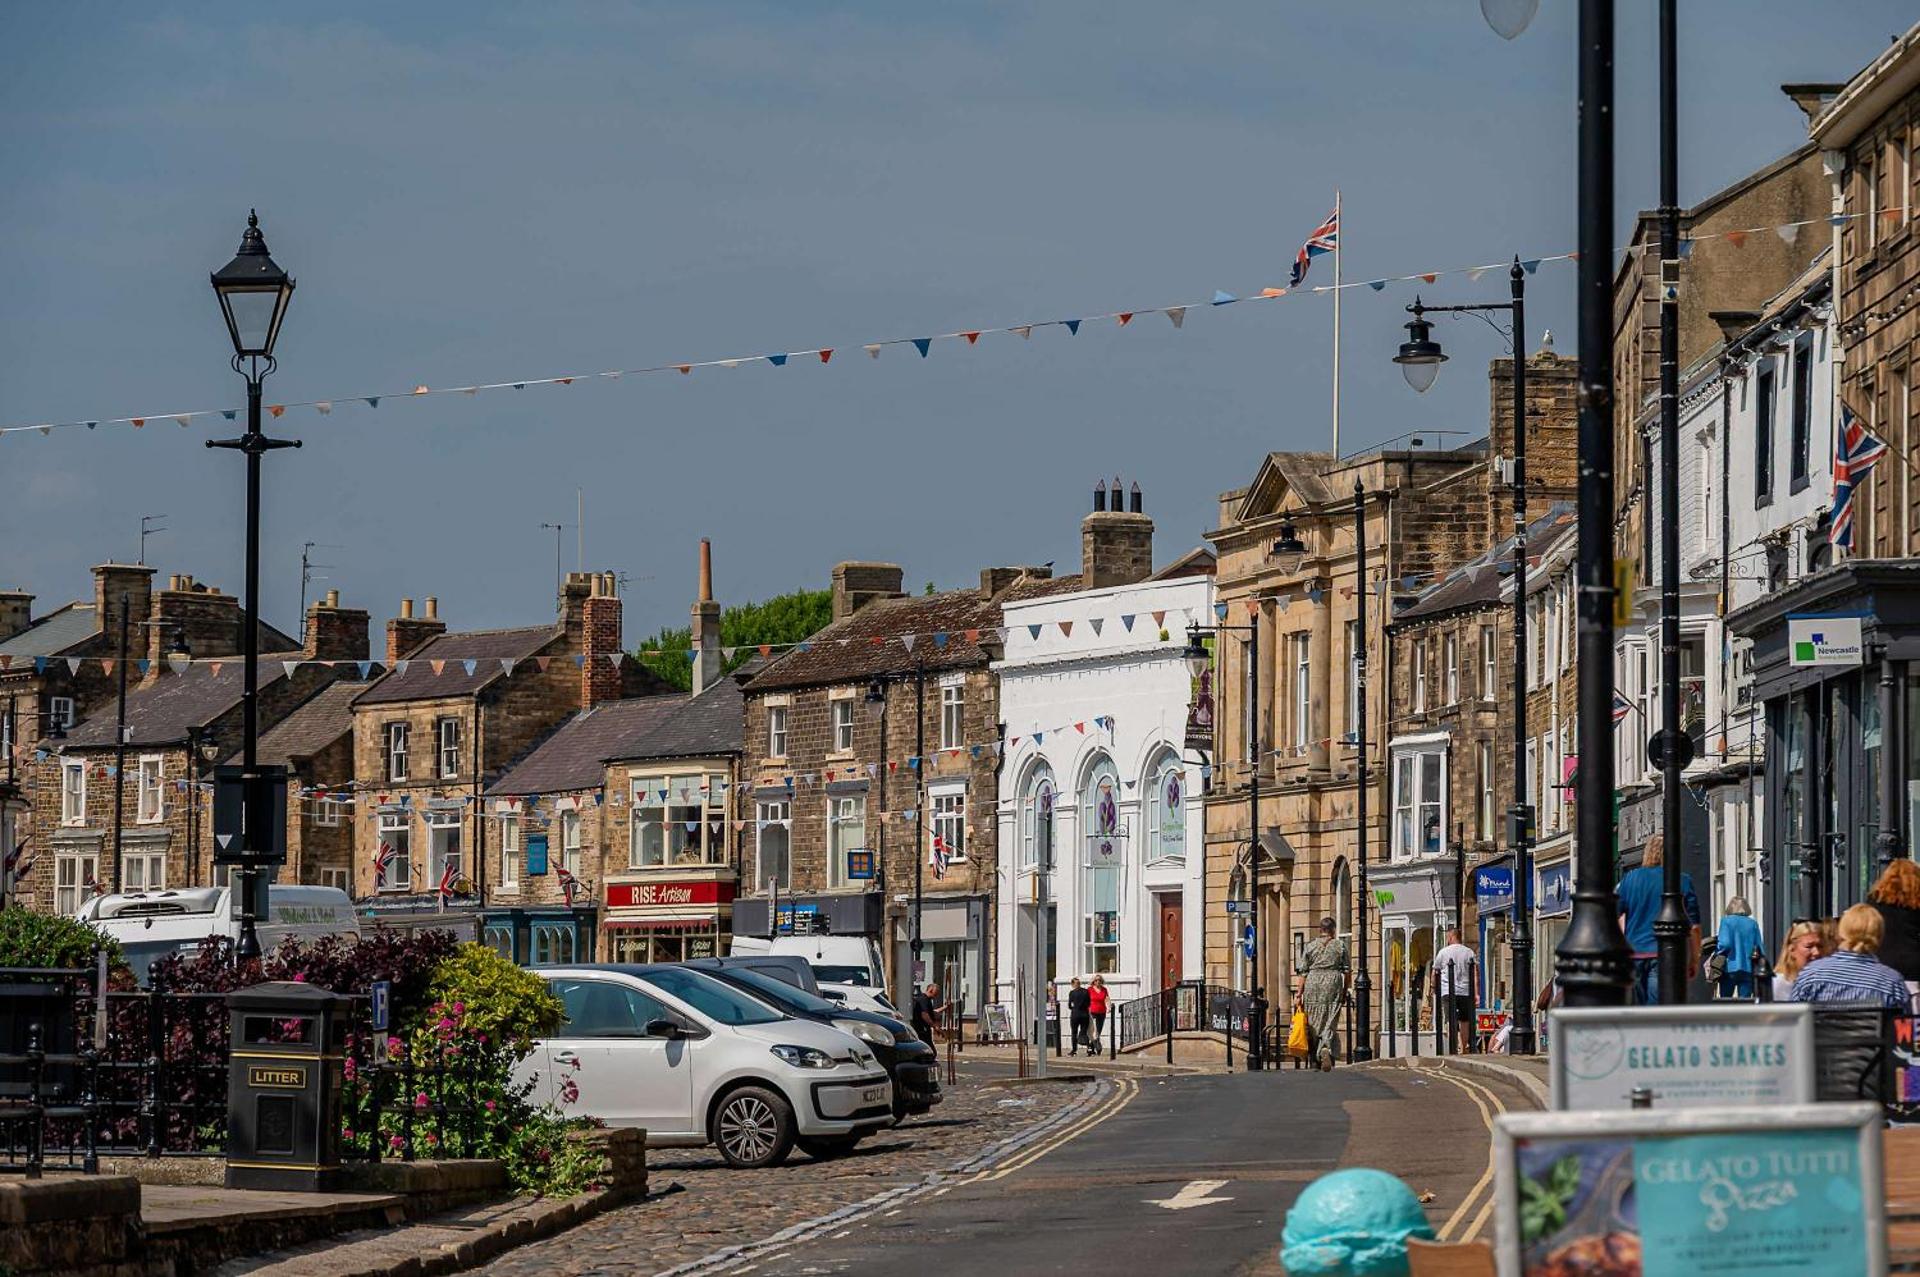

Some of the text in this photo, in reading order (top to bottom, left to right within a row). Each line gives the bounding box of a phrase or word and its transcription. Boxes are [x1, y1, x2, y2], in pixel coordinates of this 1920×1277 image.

[1818, 646, 1860, 655] Newcastle
[631, 885, 692, 904] RISE Artisan
[377, 988, 387, 1024] P
[1628, 1043, 1786, 1069] GELATO SHAKES
[255, 1071, 299, 1084] LITTER
[1641, 1150, 1850, 1183] GELATO TUTTI
